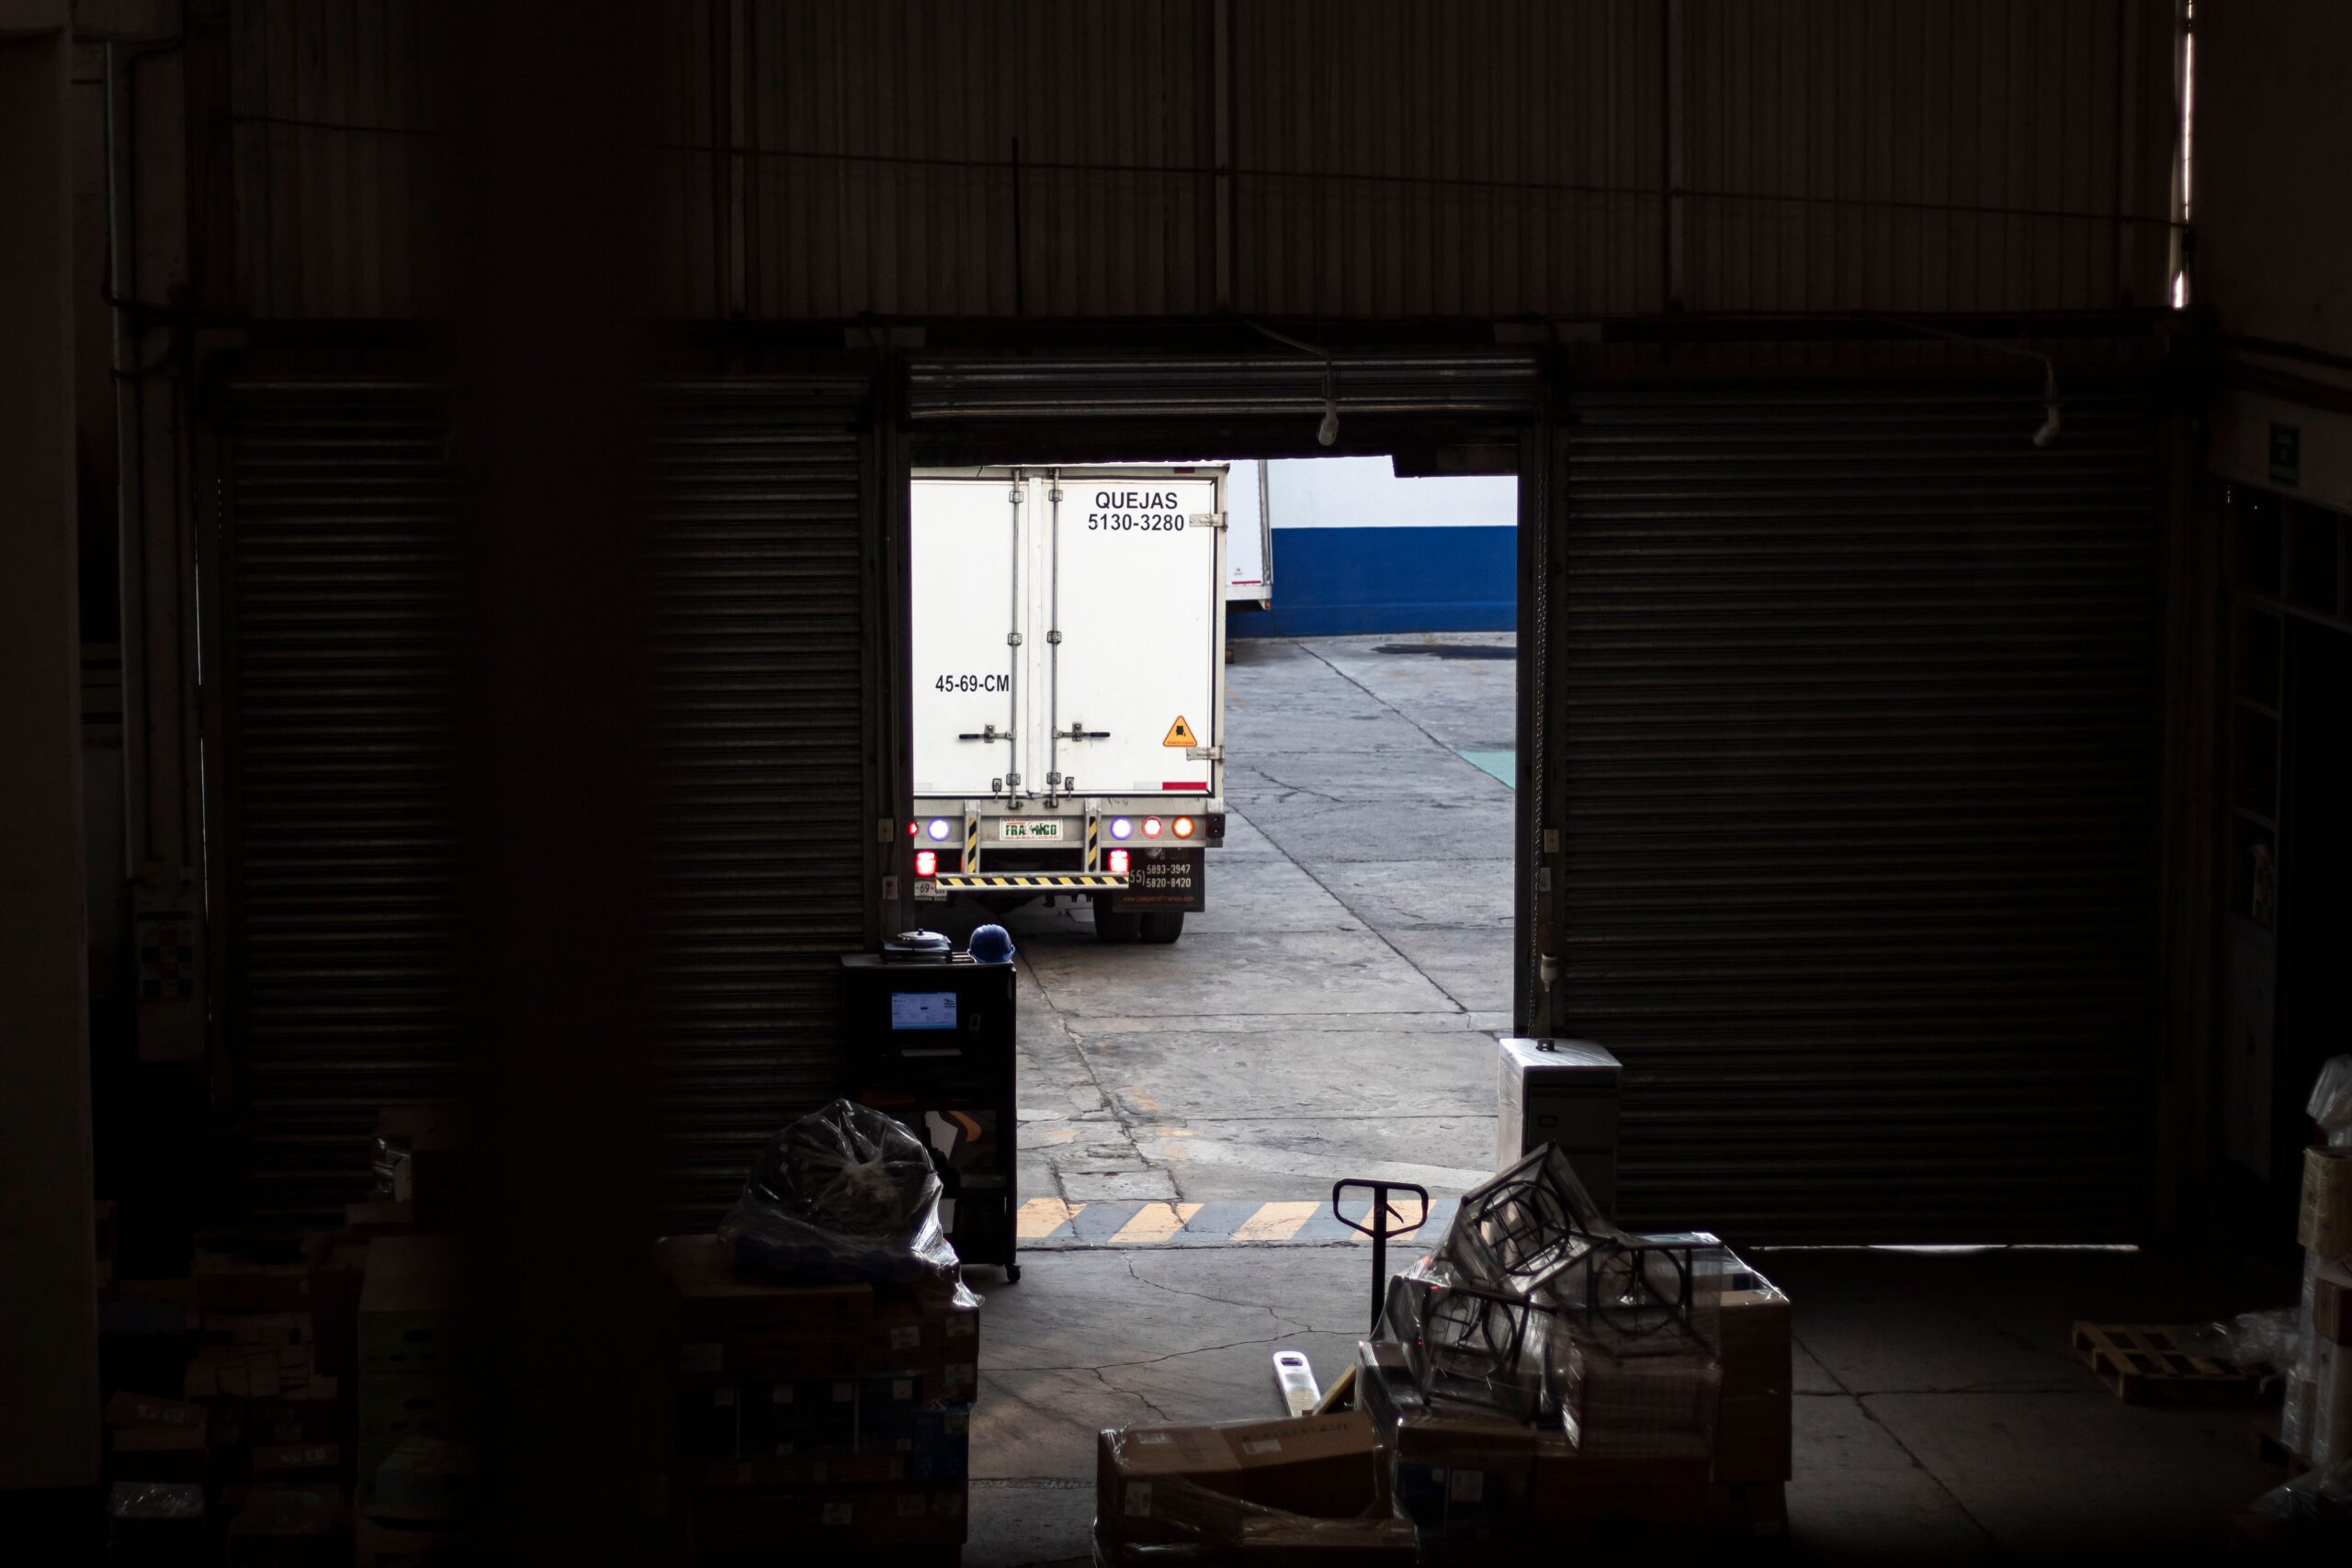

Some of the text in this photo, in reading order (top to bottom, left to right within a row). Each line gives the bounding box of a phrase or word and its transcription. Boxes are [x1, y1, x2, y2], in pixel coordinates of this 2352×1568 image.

[1095, 491, 1178, 509] QUEJAS
[1088, 513, 1184, 531] 5130-3280
[935, 674, 1010, 692] 45-69-CM
